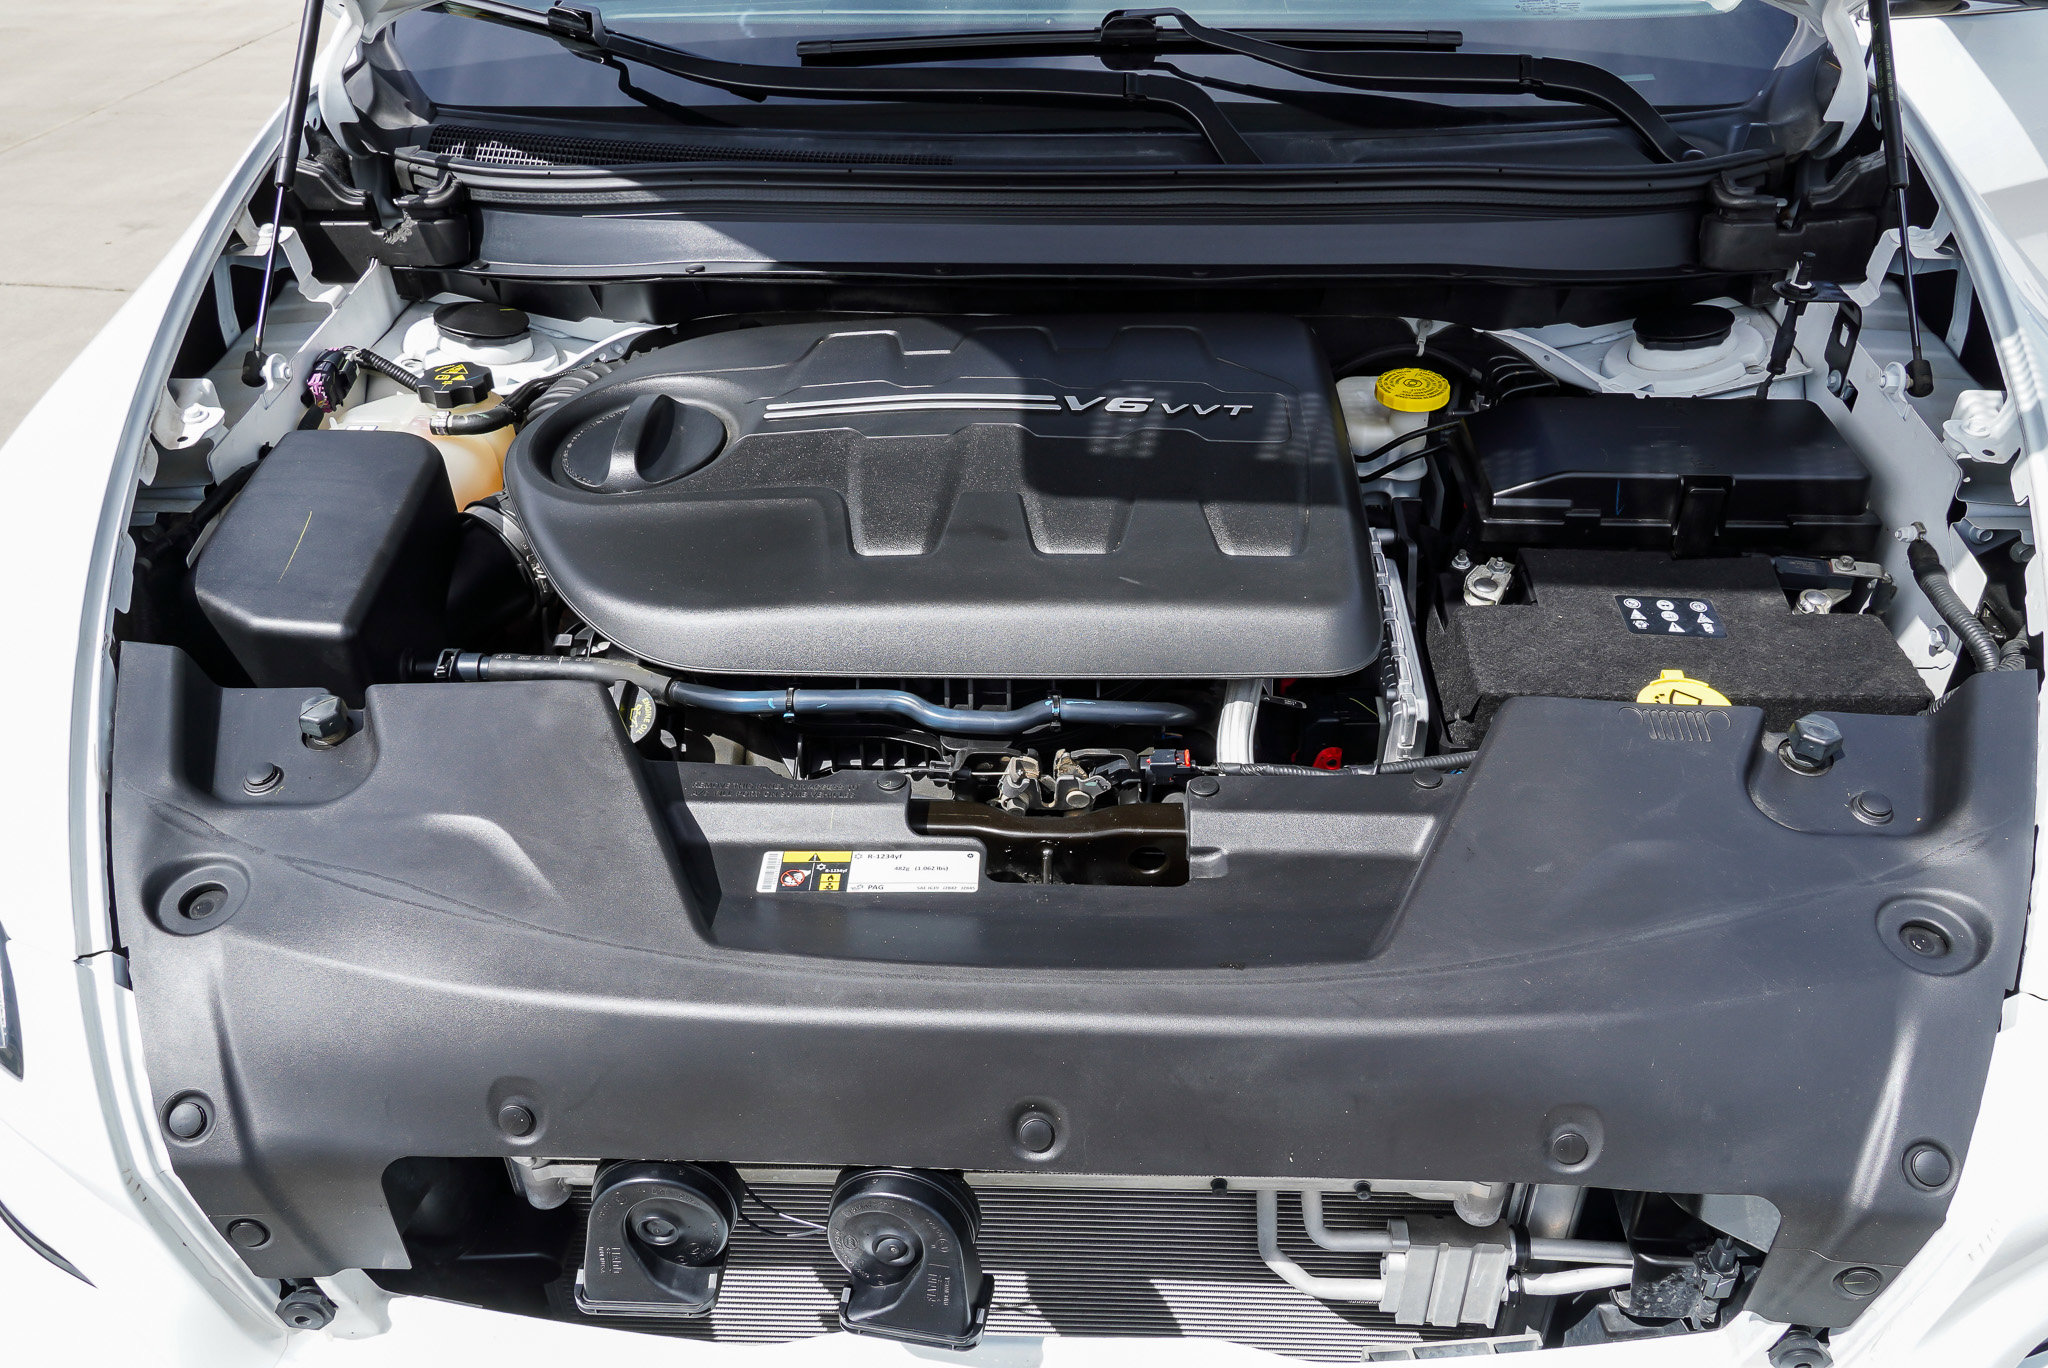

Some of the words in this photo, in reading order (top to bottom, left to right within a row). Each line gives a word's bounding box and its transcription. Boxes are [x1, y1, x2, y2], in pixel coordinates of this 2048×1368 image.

[1064, 395, 1154, 413] V6
[1161, 403, 1254, 416] VVT
[641, 697, 652, 723] ENGINE
[636, 724, 648, 734] OIL
